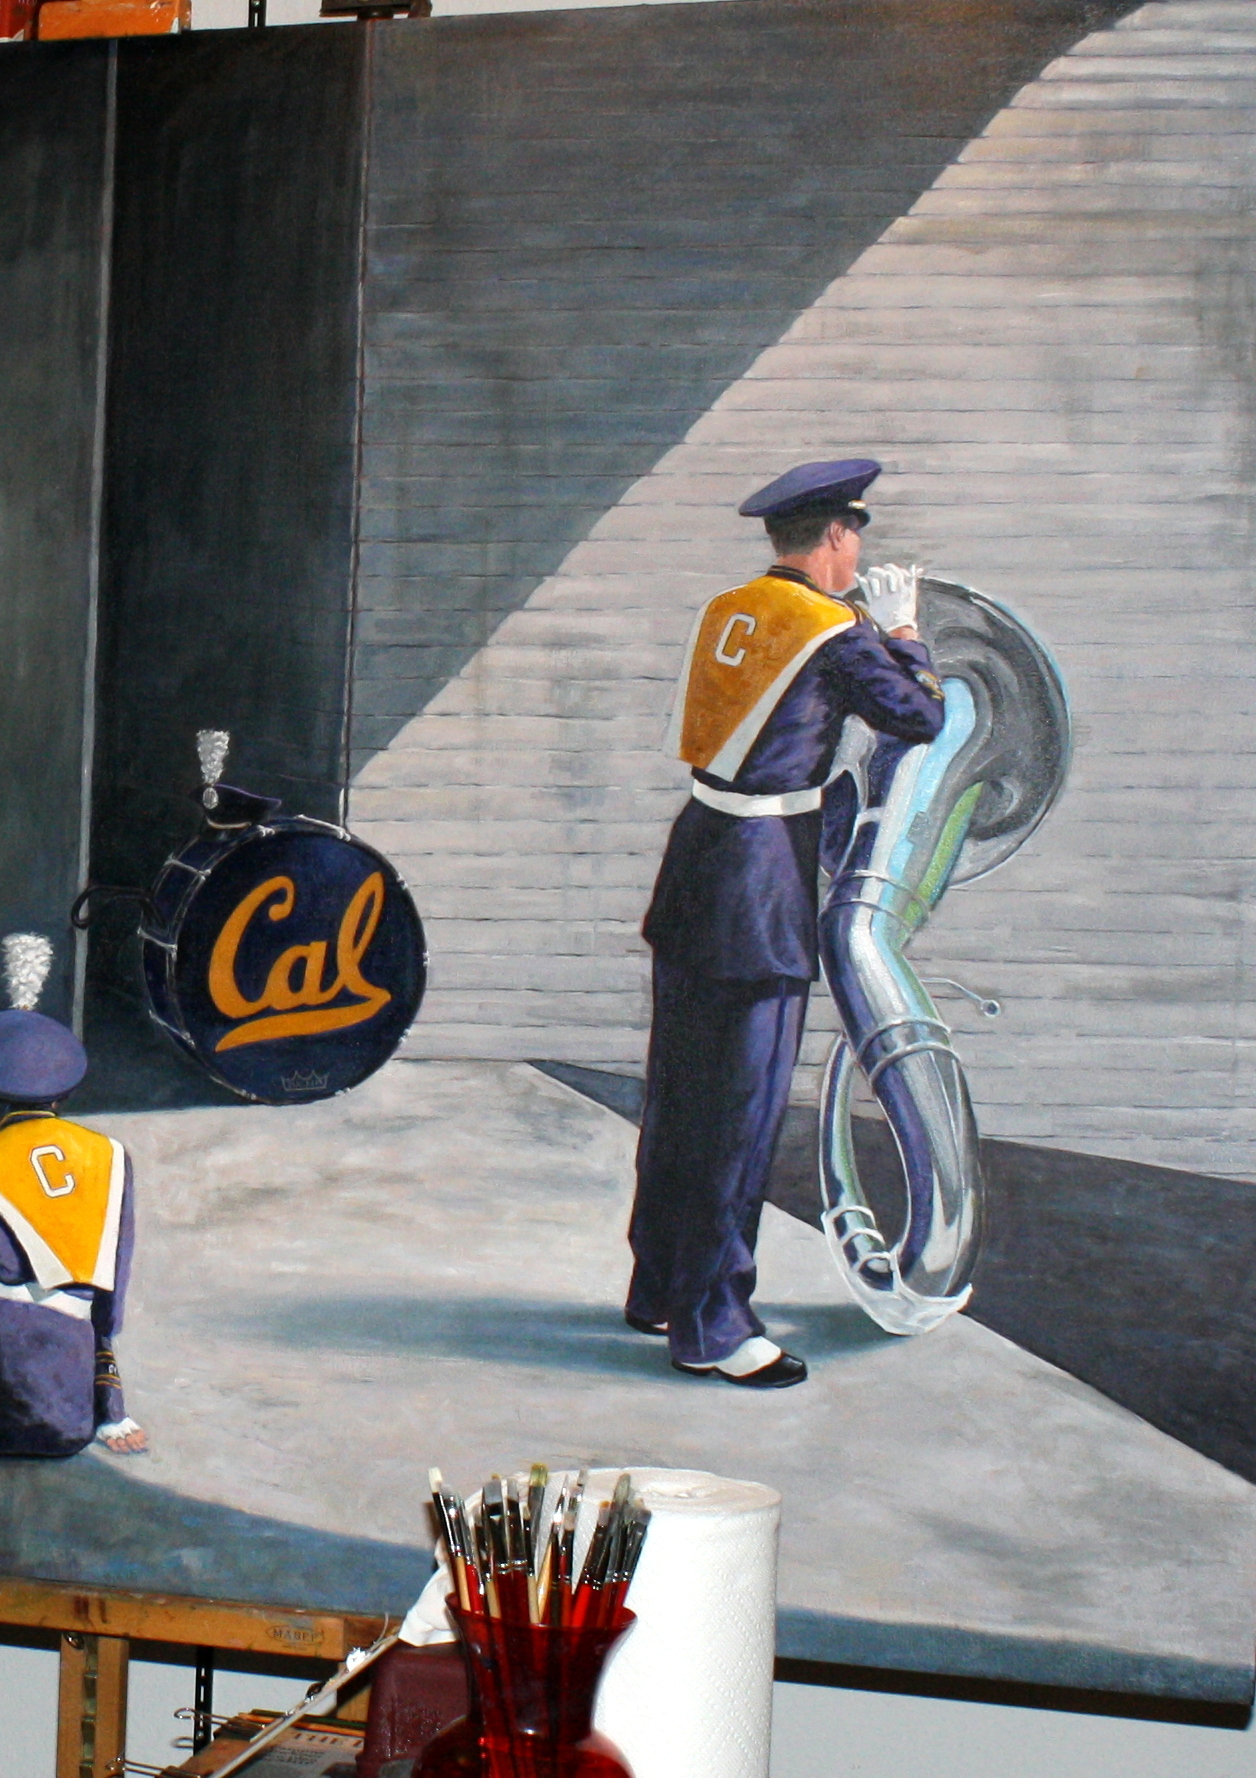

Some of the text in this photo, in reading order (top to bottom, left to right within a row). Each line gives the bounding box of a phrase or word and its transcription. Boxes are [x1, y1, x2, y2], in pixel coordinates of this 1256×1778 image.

[715, 613, 756, 667] C
[209, 872, 389, 1020] Cal
[30, 1145, 75, 1197] C
